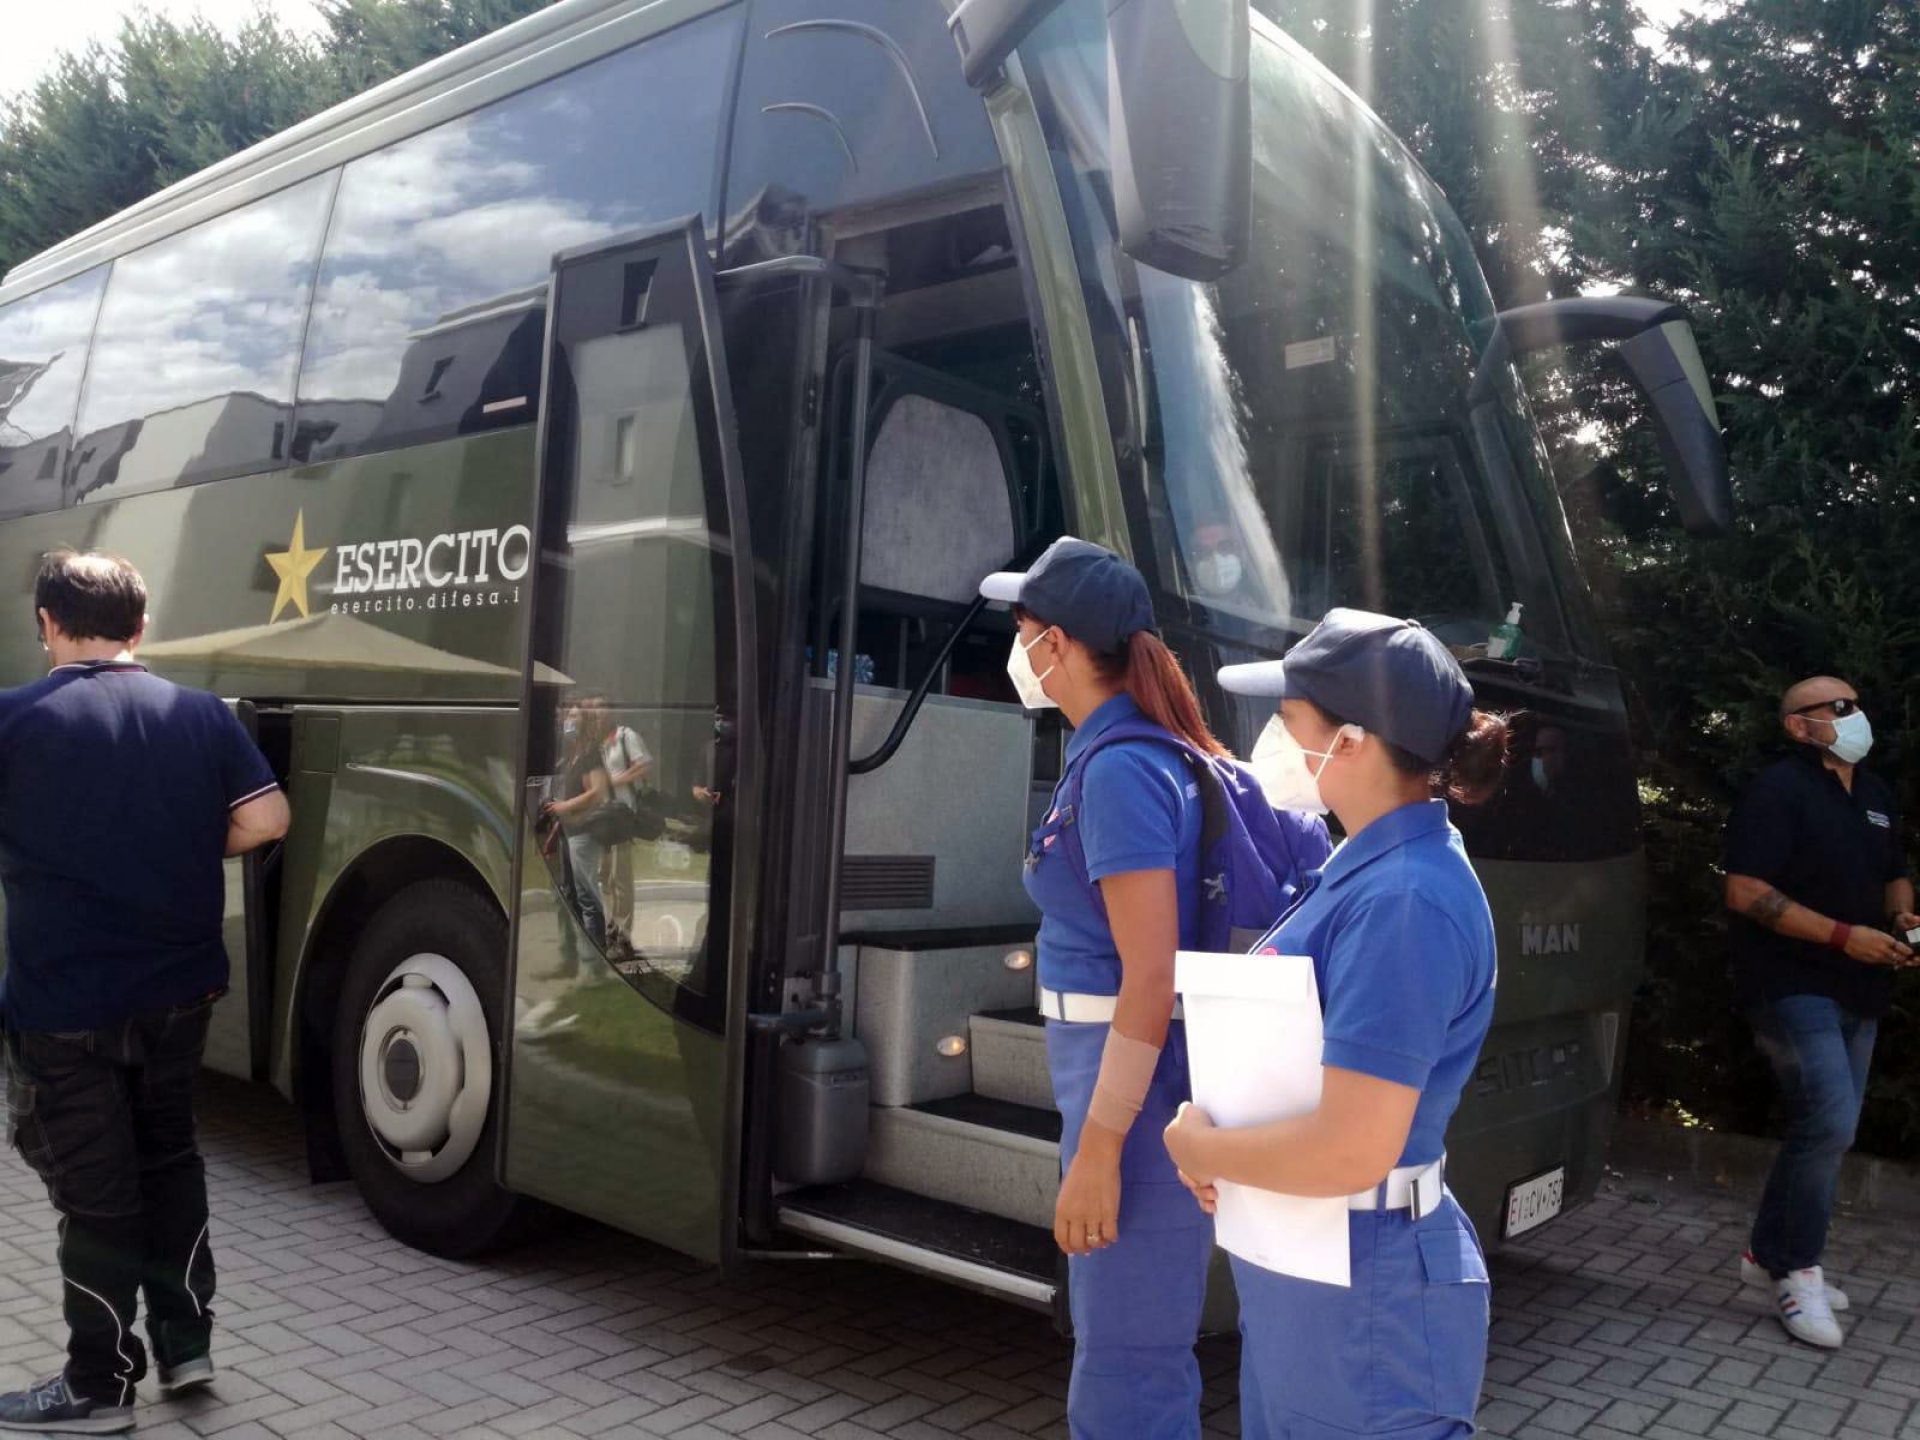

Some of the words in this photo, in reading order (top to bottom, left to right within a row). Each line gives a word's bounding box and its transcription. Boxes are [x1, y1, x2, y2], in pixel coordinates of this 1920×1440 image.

[332, 524, 531, 594] ESERCITO
[330, 586, 520, 615] esercito.difesa.i
[1521, 922, 1580, 955] MAN
[37, 1381, 67, 1411] N
